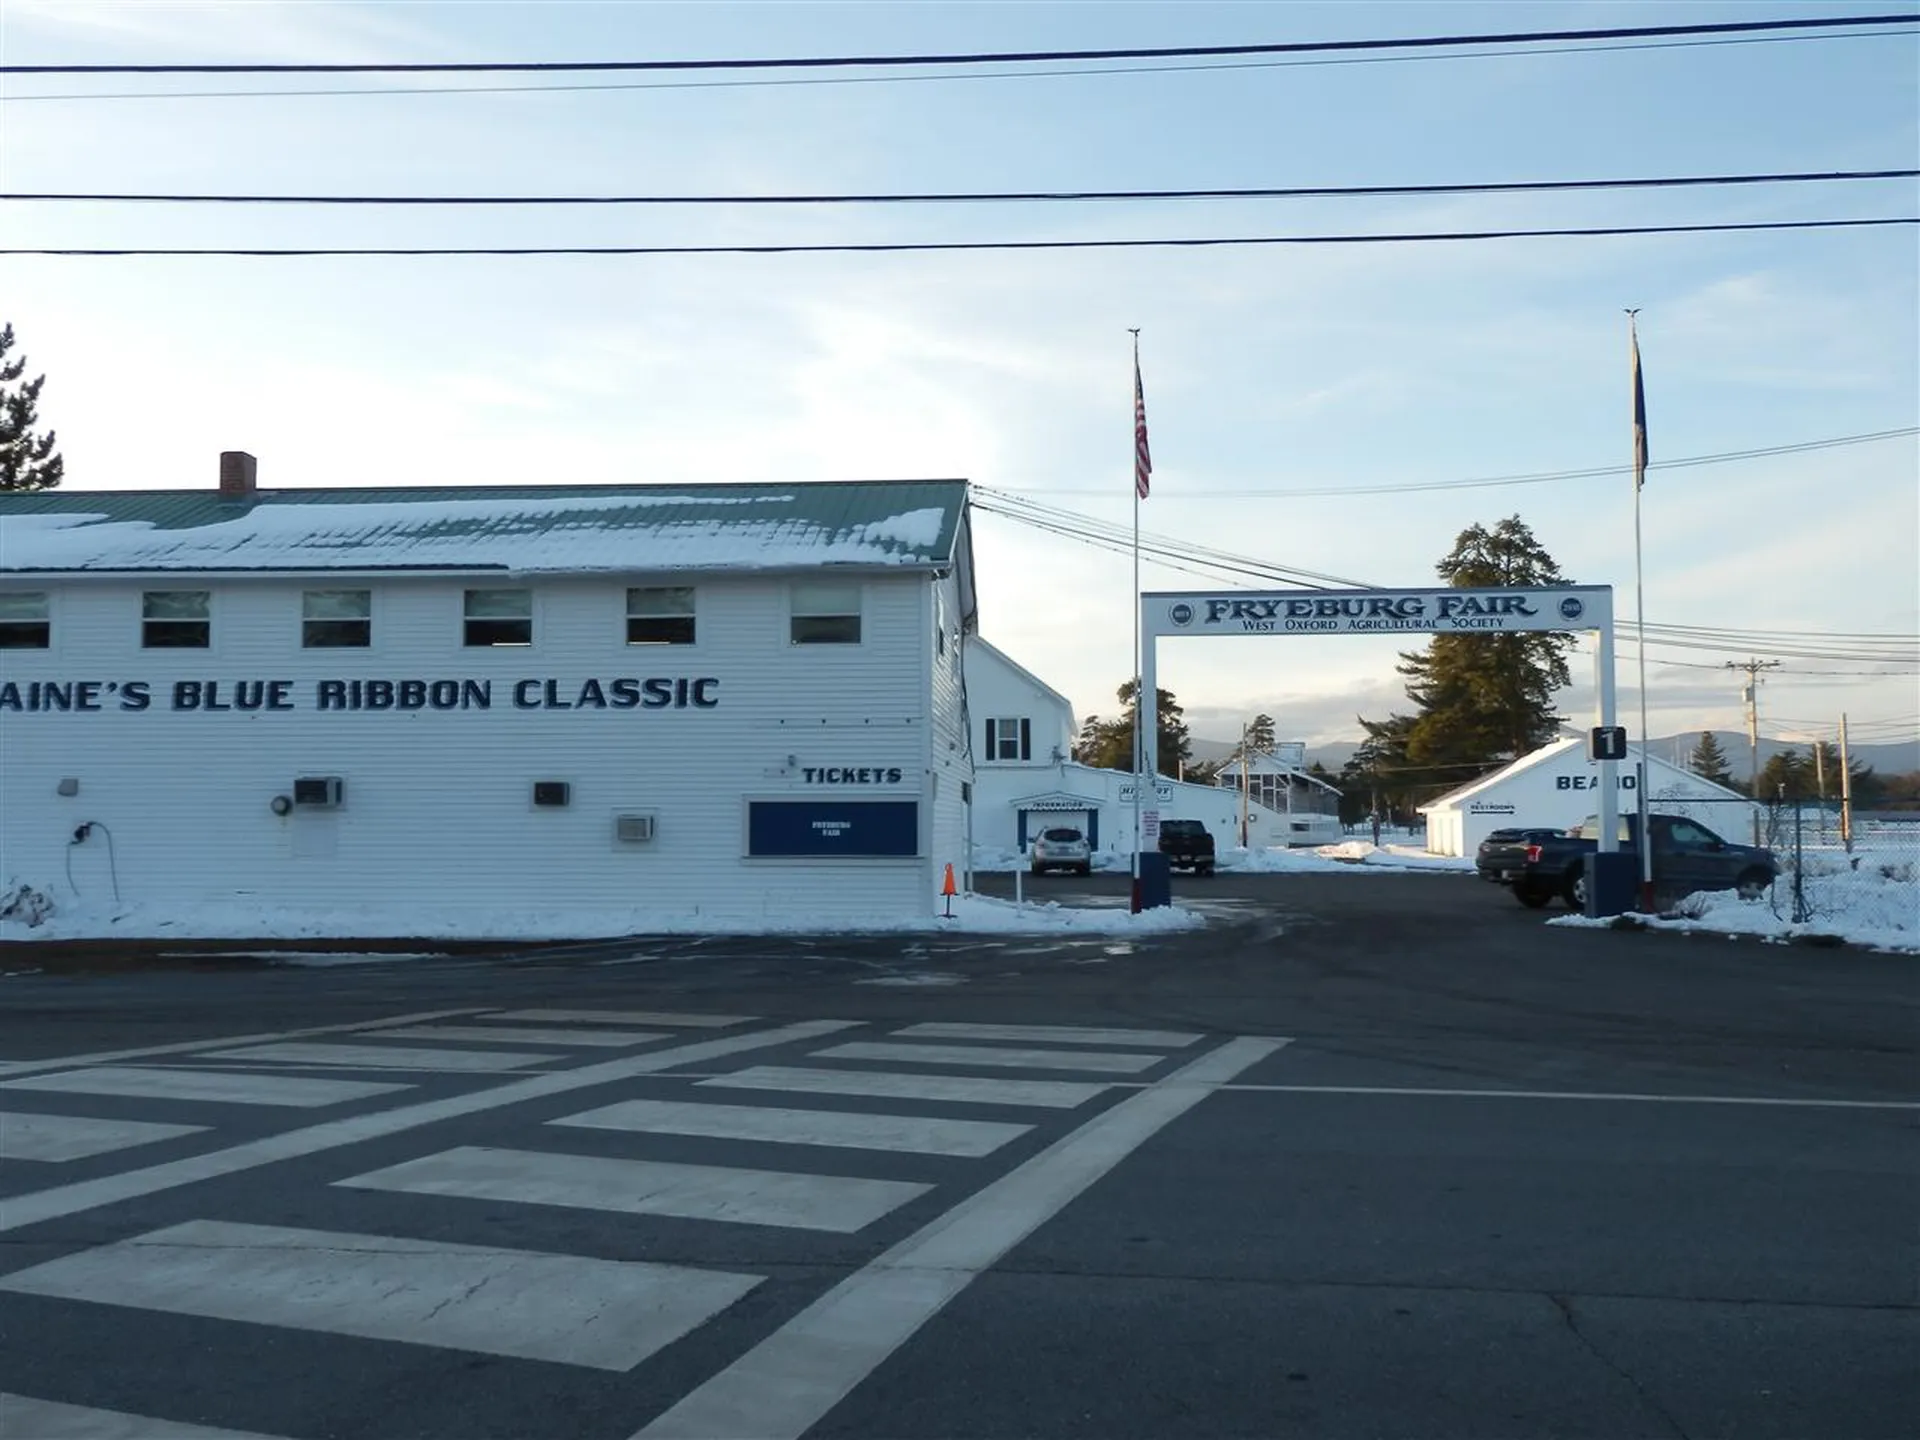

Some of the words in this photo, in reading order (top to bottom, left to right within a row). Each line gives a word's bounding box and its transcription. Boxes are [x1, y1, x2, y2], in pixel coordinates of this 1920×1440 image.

[1204, 597, 1428, 624] FRYEBURG
[1435, 596, 1539, 619] FAIR
[1242, 619, 1276, 631] WEST
[1285, 618, 1338, 630] OXFORD
[1347, 618, 1438, 630] AGRICULTURAL
[1451, 617, 1504, 628] SOCIETY
[0, 680, 151, 712] AINE'S
[171, 680, 295, 712] BLUE
[316, 679, 492, 711] RIBBON
[513, 677, 720, 710] CLASSIC
[1602, 732, 1615, 754] 1
[802, 767, 902, 784] TICKETS
[1556, 776, 1636, 790] BEAO
